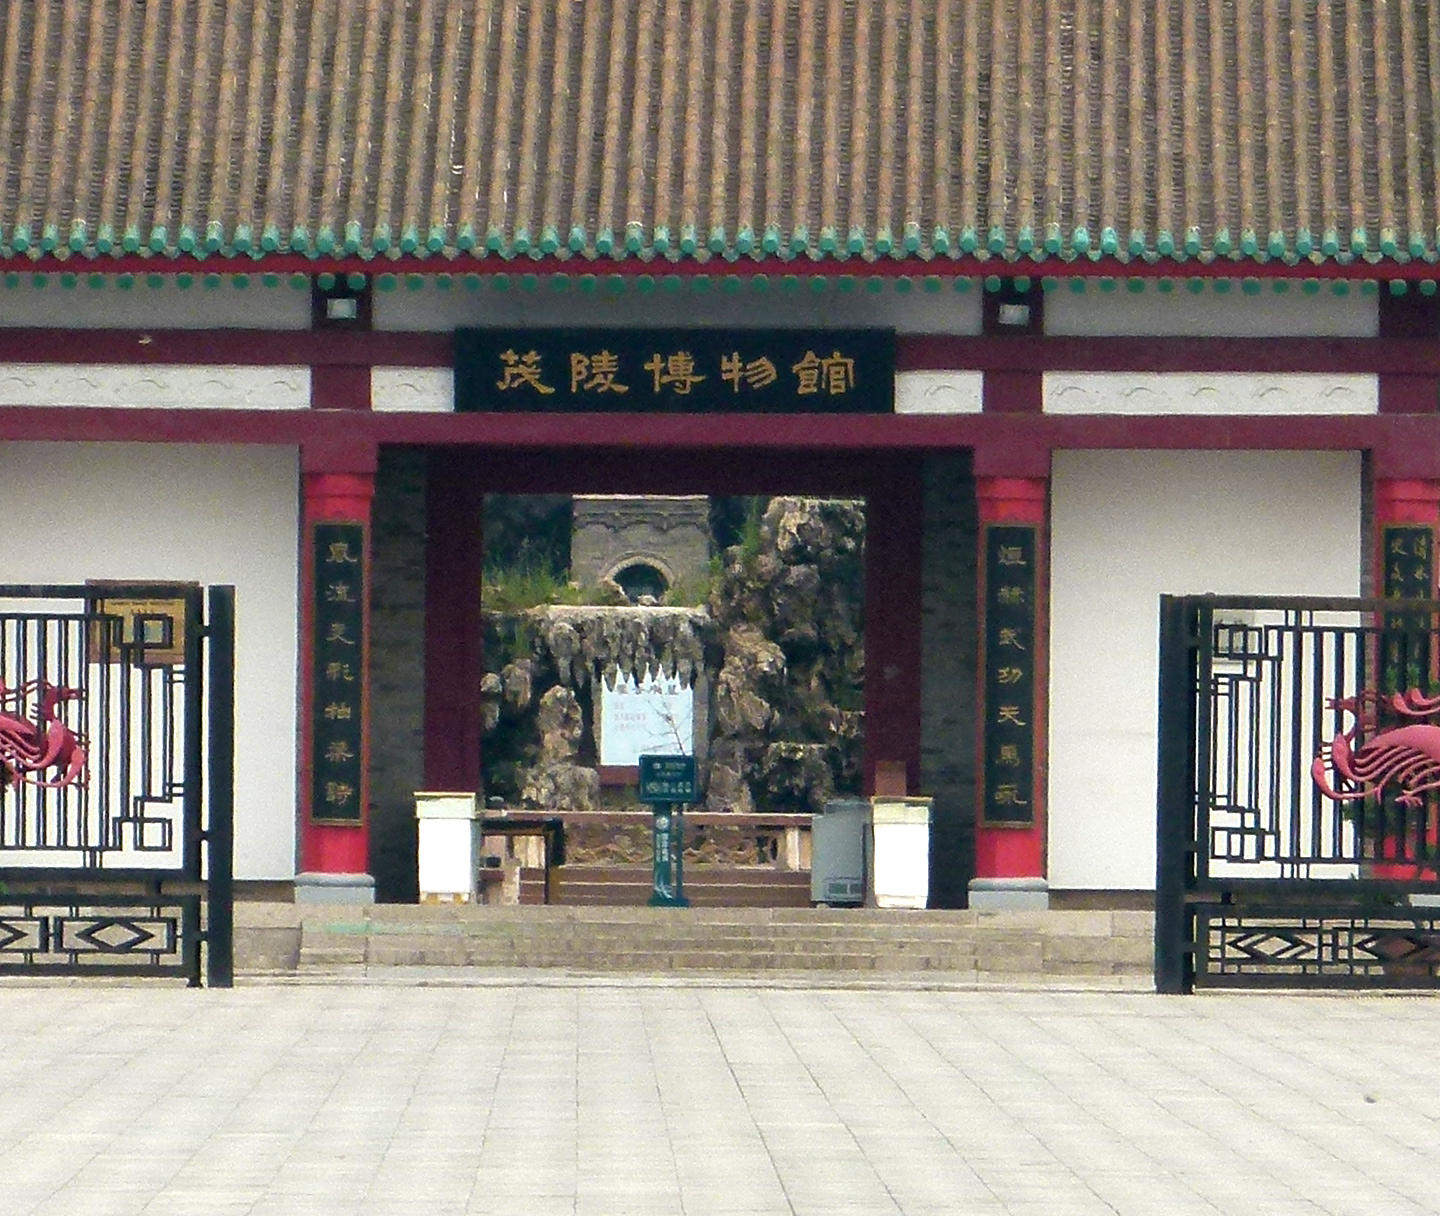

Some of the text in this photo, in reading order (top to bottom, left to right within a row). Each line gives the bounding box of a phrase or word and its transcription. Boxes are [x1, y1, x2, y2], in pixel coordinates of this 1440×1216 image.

[496, 347, 856, 397] 茂陵博物館
